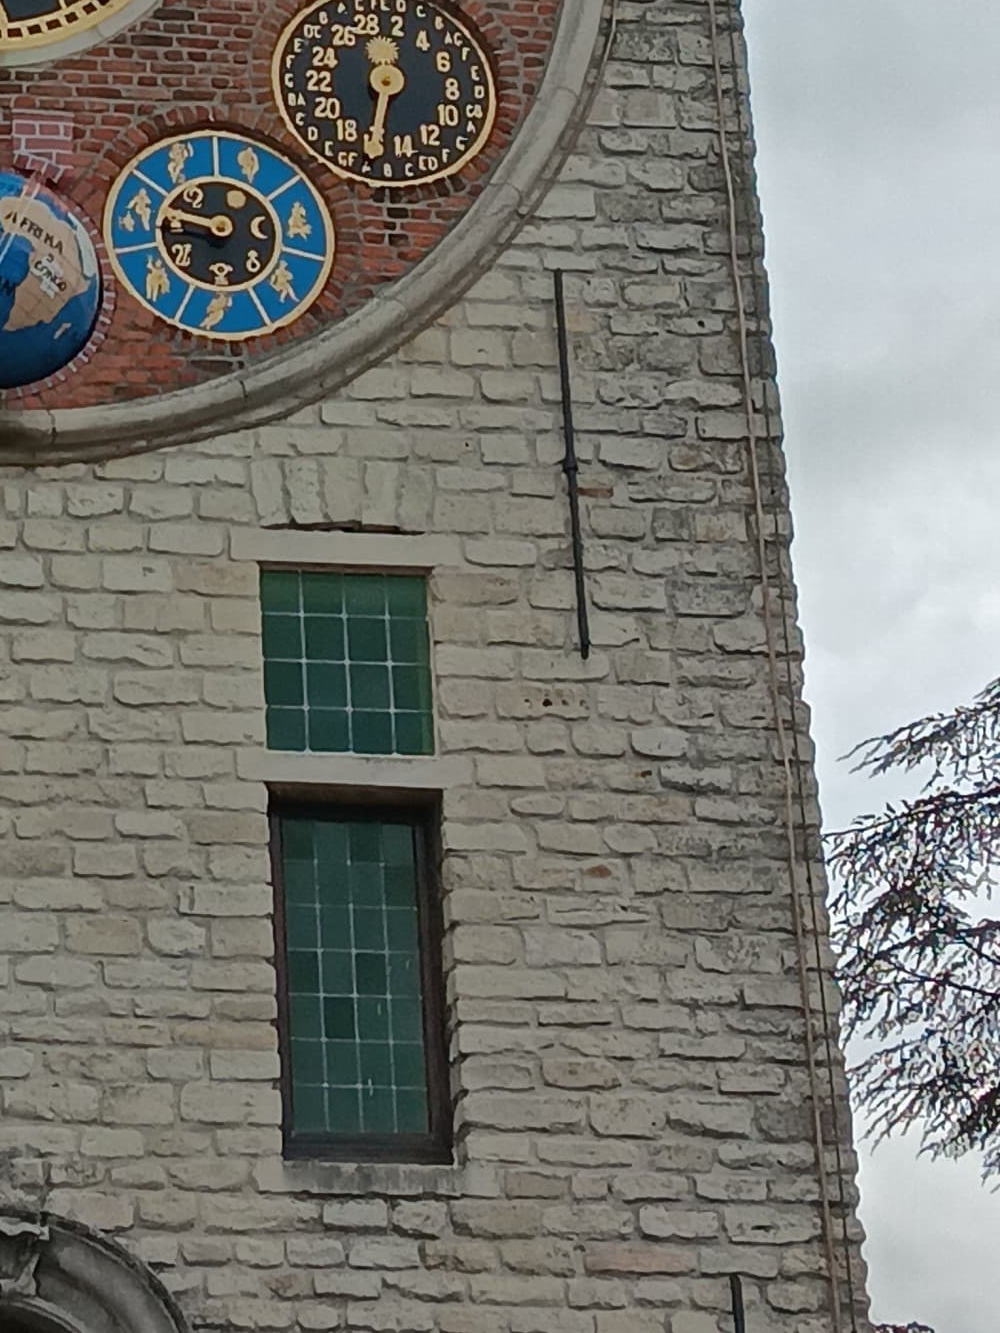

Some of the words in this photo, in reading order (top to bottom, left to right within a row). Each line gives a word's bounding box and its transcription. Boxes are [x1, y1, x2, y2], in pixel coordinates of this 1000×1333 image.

[396, 0, 406, 12] D
[354, 14, 379, 35] 28
[391, 16, 405, 37] 2
[435, 16, 444, 30] B
[294, 39, 302, 52] E
[332, 25, 355, 46] 26
[416, 30, 430, 51] 4
[286, 55, 295, 69] F
[312, 47, 338, 67] 24
[436, 52, 450, 72] 6
[462, 47, 470, 61] F
[306, 70, 332, 92] 22
[470, 67, 479, 80] E
[446, 78, 459, 100] 8
[475, 86, 484, 98] D
[314, 98, 340, 119] 20
[438, 104, 458, 126] 10
[308, 127, 318, 141] D
[336, 119, 357, 141] 18
[420, 125, 440, 146] 12
[466, 121, 475, 133] A
[394, 135, 418, 157] 14
[442, 149, 450, 162] F
[384, 164, 392, 177] B
[405, 164, 414, 176] C
